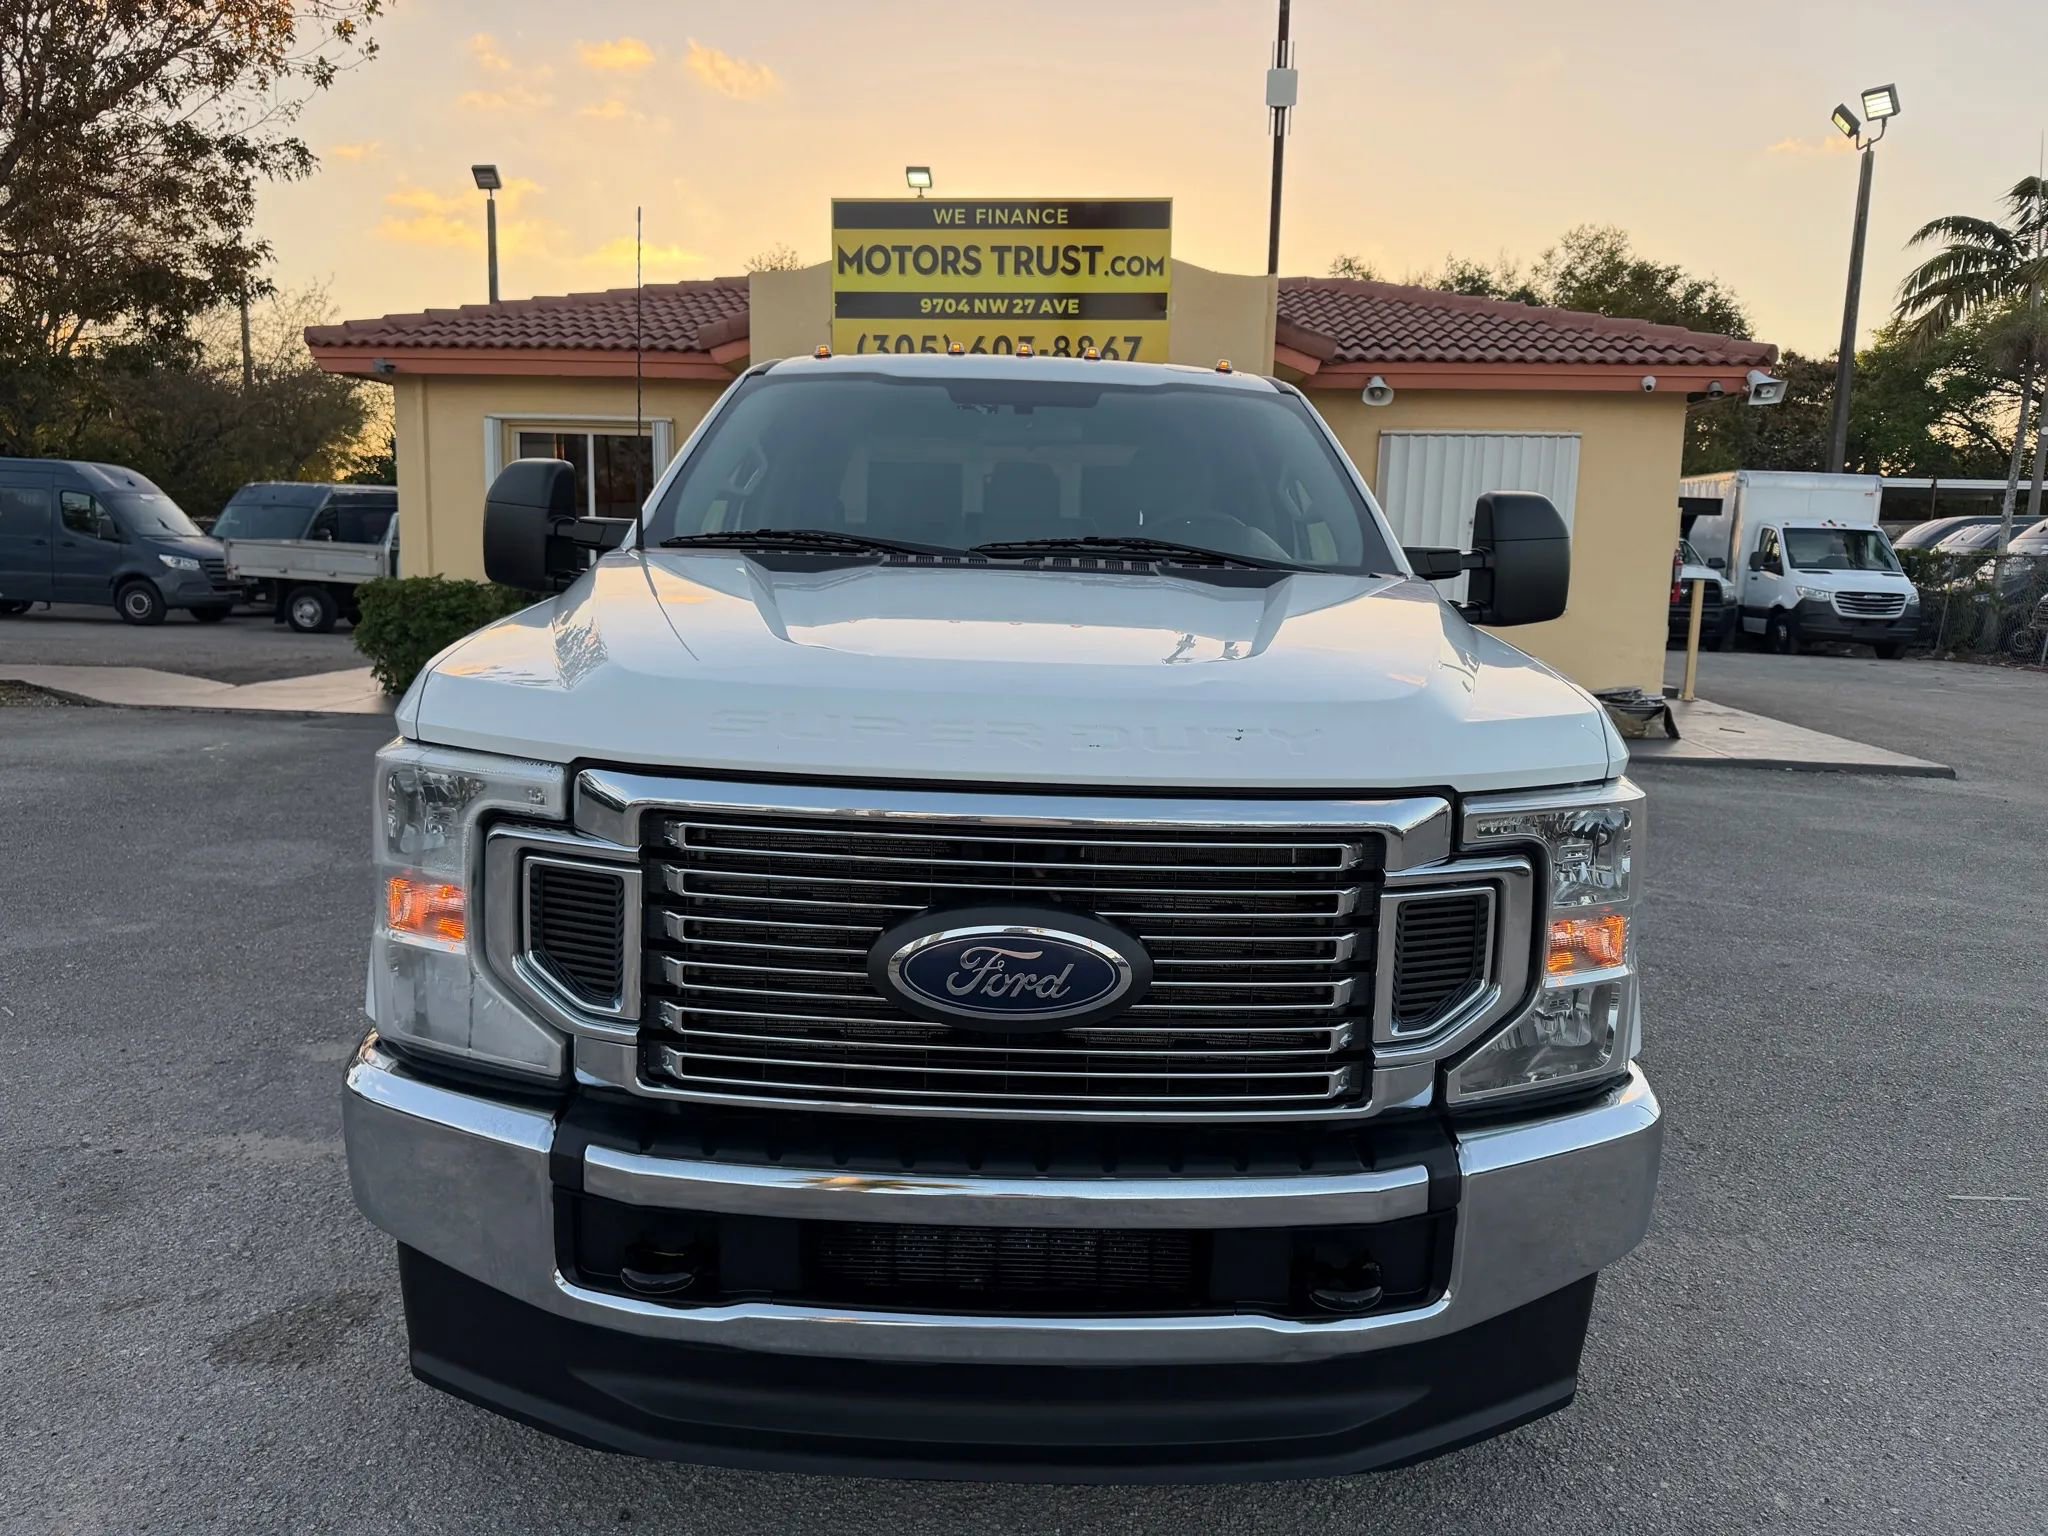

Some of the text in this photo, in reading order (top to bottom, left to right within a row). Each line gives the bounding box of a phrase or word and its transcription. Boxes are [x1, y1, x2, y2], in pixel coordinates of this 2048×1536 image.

[933, 208, 1069, 225] WE FINANCE
[837, 244, 1165, 277] MOTORS TRUST.COM
[920, 298, 1080, 314] 9704 NW 27 AVE
[707, 708, 1327, 757] SUPER DUTY
[946, 946, 1075, 999] Ford
